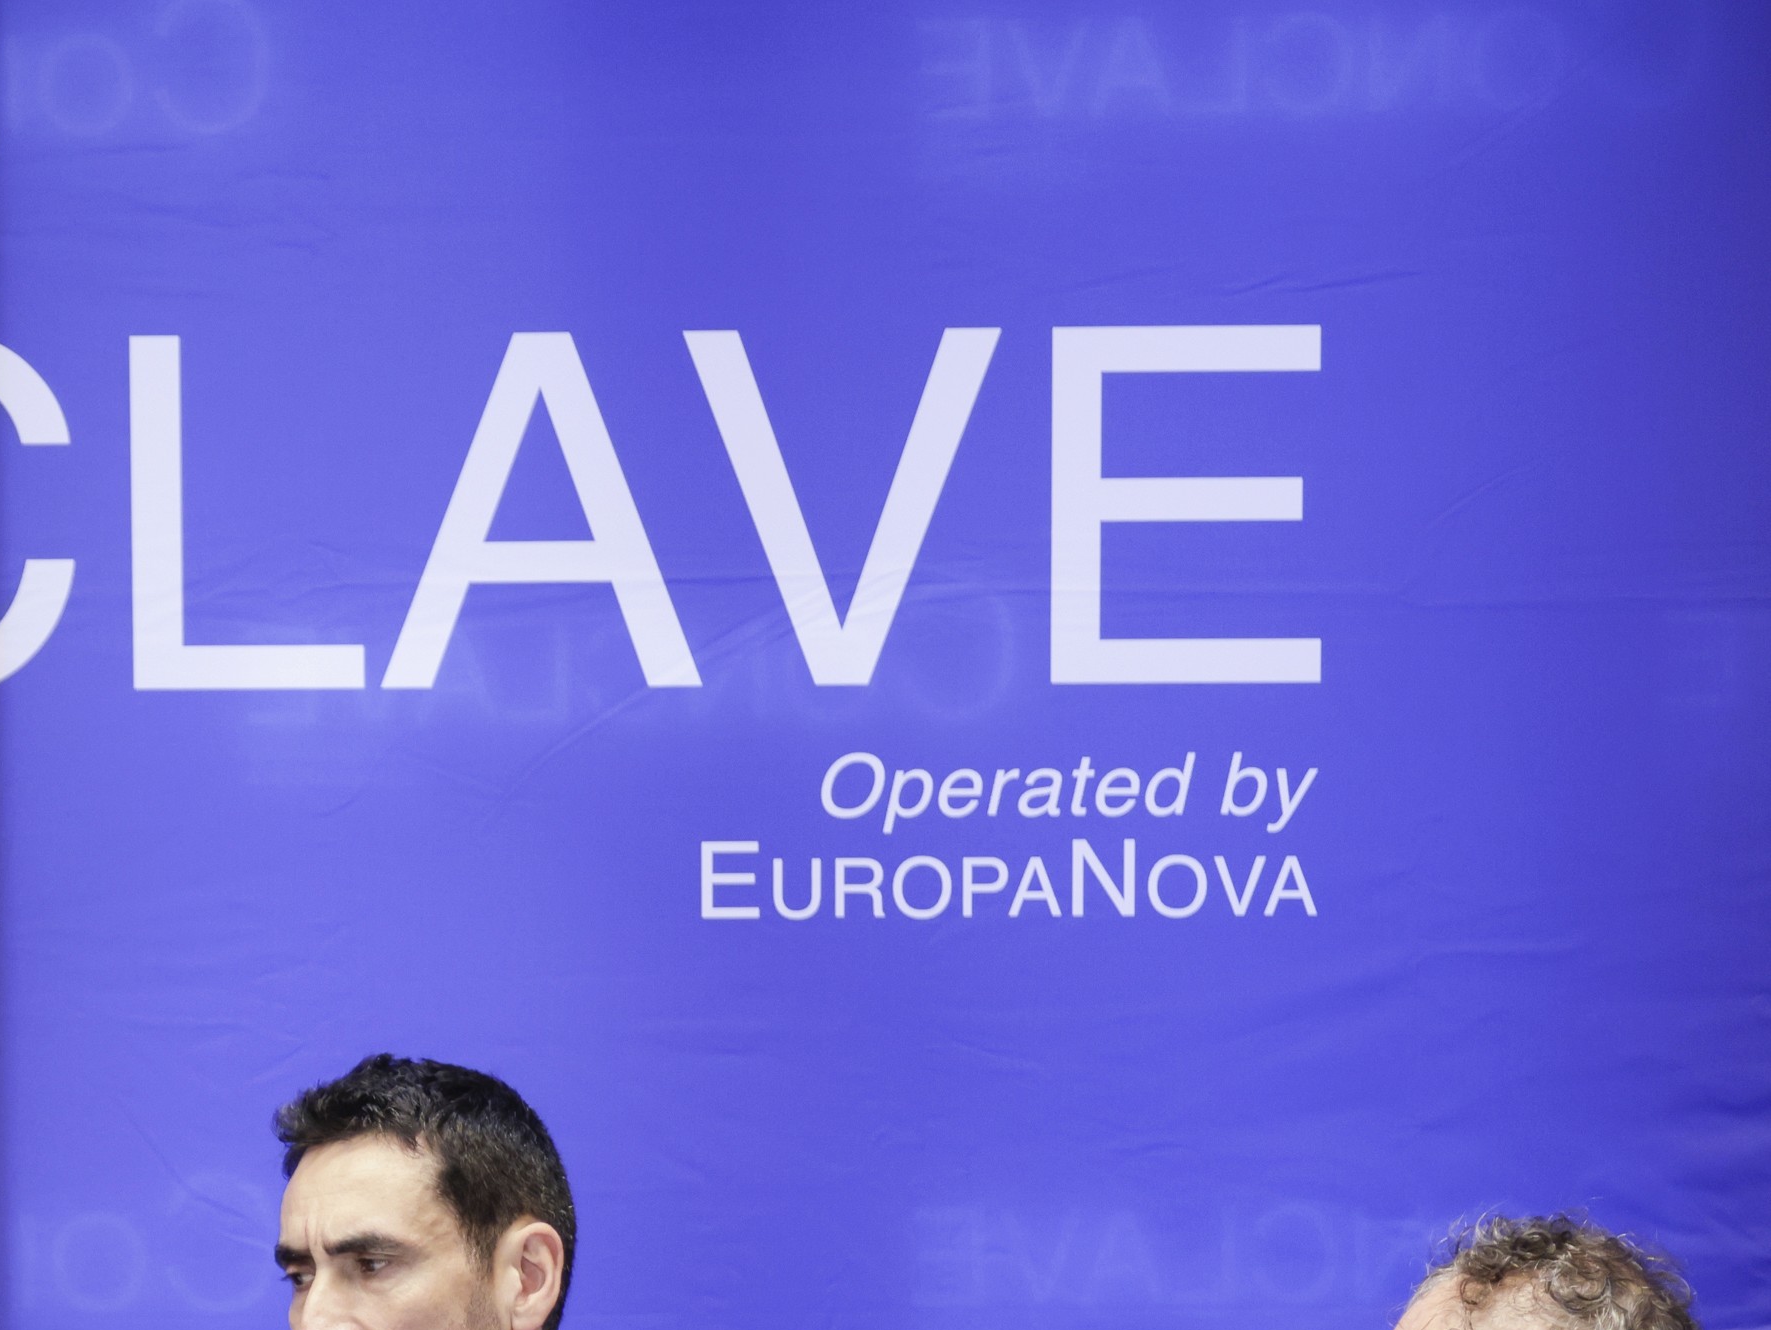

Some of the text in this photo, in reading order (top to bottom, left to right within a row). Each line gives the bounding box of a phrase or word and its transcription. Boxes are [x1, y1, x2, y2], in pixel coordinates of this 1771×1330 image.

[819, 751, 1319, 835] Operated by
[700, 838, 1319, 921] EUROPANOVA
